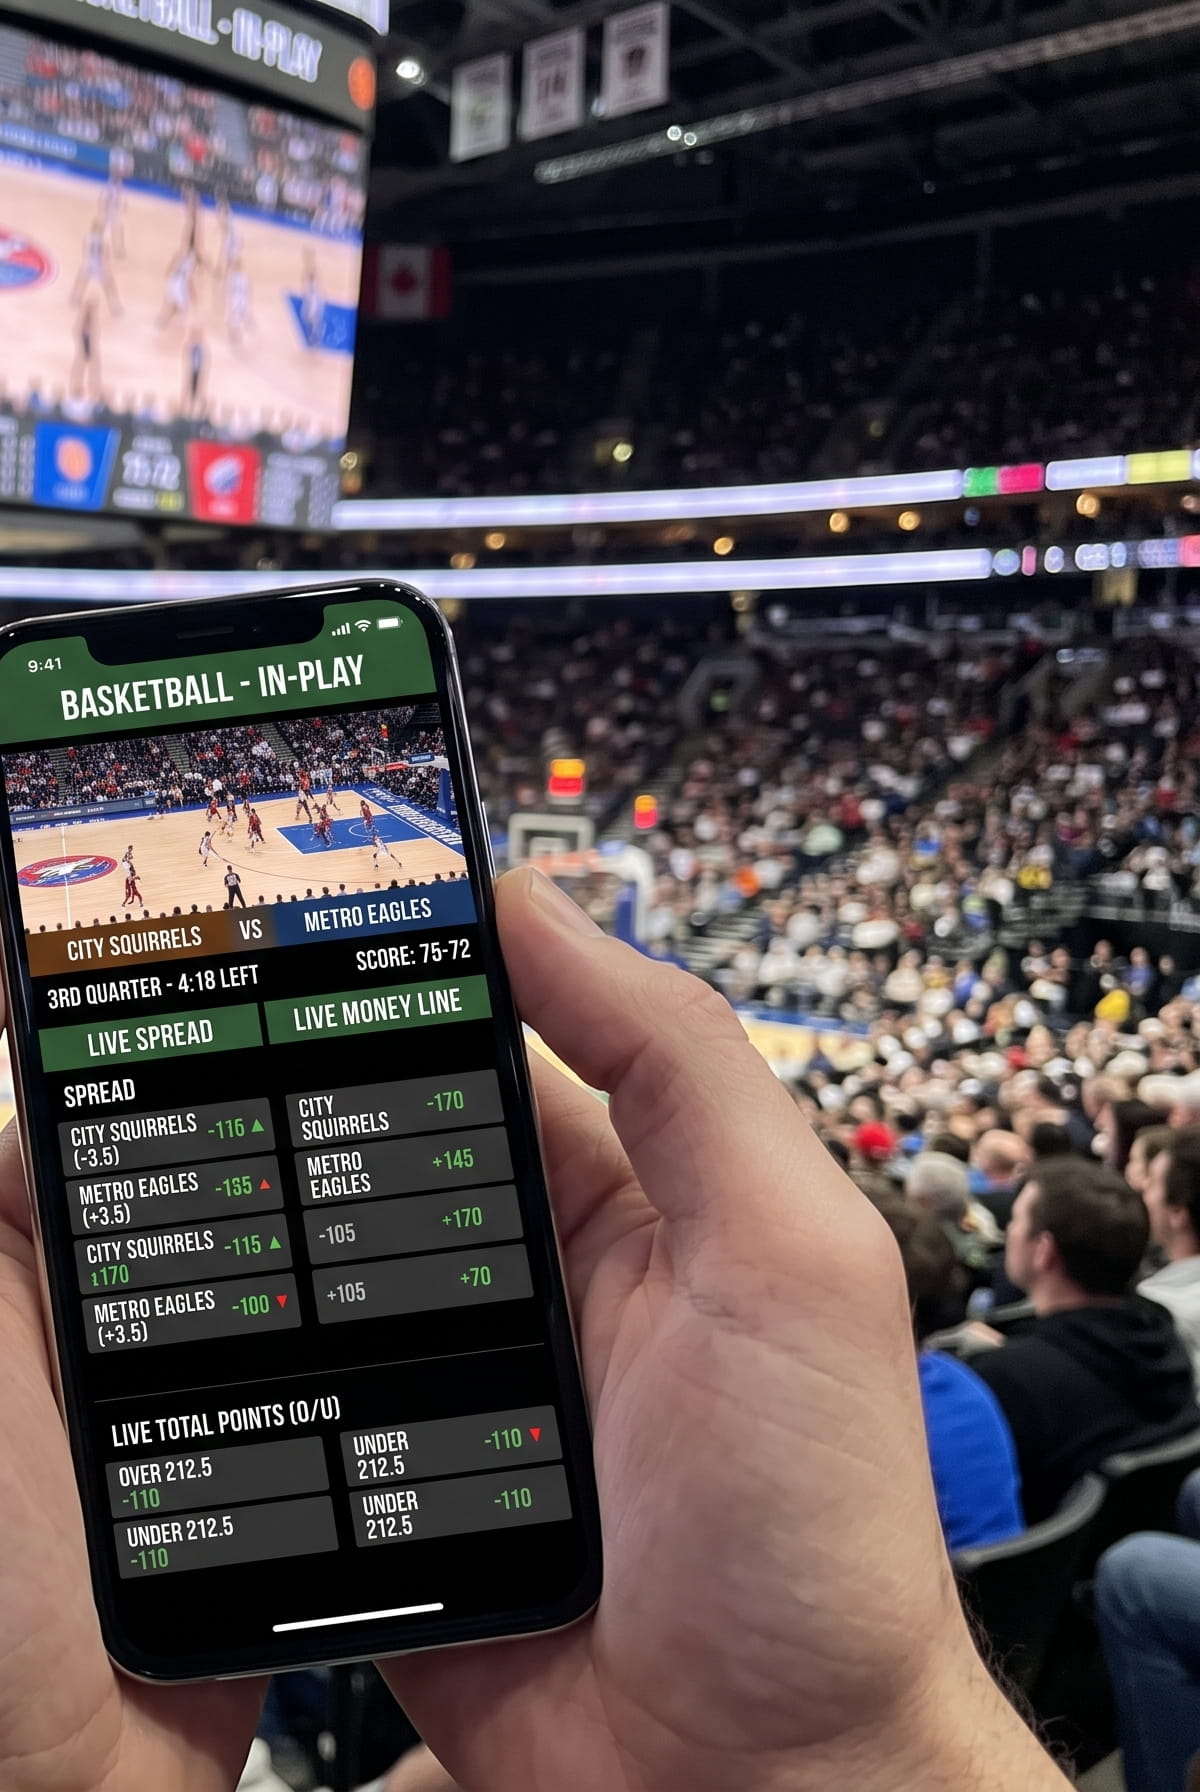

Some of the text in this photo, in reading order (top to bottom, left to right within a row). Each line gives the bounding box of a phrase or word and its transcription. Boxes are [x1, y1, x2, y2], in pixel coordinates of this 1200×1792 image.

[28, 658, 61, 672] 9:41
[61, 672, 233, 720] BASKETBALL
[258, 655, 363, 696] IN-PLAY
[68, 898, 431, 960] CITY SQUIRRELS VS METRO EAGLES
[356, 939, 470, 970] SCORE: 75-72
[48, 987, 81, 1009] 3RD
[86, 977, 162, 1004] QUARTER
[179, 970, 215, 992] 4:18
[220, 965, 258, 988] LEFT
[294, 988, 462, 1031] LIVE MONEY LINE
[88, 1020, 213, 1056] LIVE SPREAD
[64, 1079, 135, 1107] SPREAD
[428, 1091, 463, 1111] -170
[299, 1096, 333, 1117] CITY
[71, 1124, 104, 1146] CITY
[110, 1113, 197, 1141] SQUIRRELS
[302, 1112, 389, 1140] SQUIRRELS
[74, 1145, 119, 1170] (-3.5)
[307, 1152, 362, 1176] METRO
[433, 1149, 473, 1169] +145
[79, 1180, 134, 1204] METRO
[139, 1172, 198, 1197] EAGLES
[311, 1173, 370, 1198] EAGLES
[83, 1203, 130, 1229] (+3.5)
[443, 1207, 482, 1227] +170
[319, 1223, 355, 1244] -105
[87, 1231, 261, 1263] CITY SQUIRRELS -115
[461, 1266, 491, 1286] +70
[328, 1282, 365, 1302] +105
[94, 1290, 269, 1323] METRO EAGLES -100
[98, 1321, 147, 1347] (+3.5)
[112, 1396, 340, 1447] LIVE TOTAL POINTS (O/U)
[354, 1431, 408, 1455] UNDER
[485, 1429, 521, 1449] -110
[119, 1457, 211, 1486] OVER 212.5
[358, 1455, 404, 1479] 212.5
[123, 1489, 159, 1509] -110
[363, 1491, 418, 1515] UNDER
[495, 1488, 531, 1509] -110
[127, 1516, 233, 1547] UNDER 212.5
[367, 1515, 412, 1539] 212.5
[132, 1549, 168, 1569] -110
